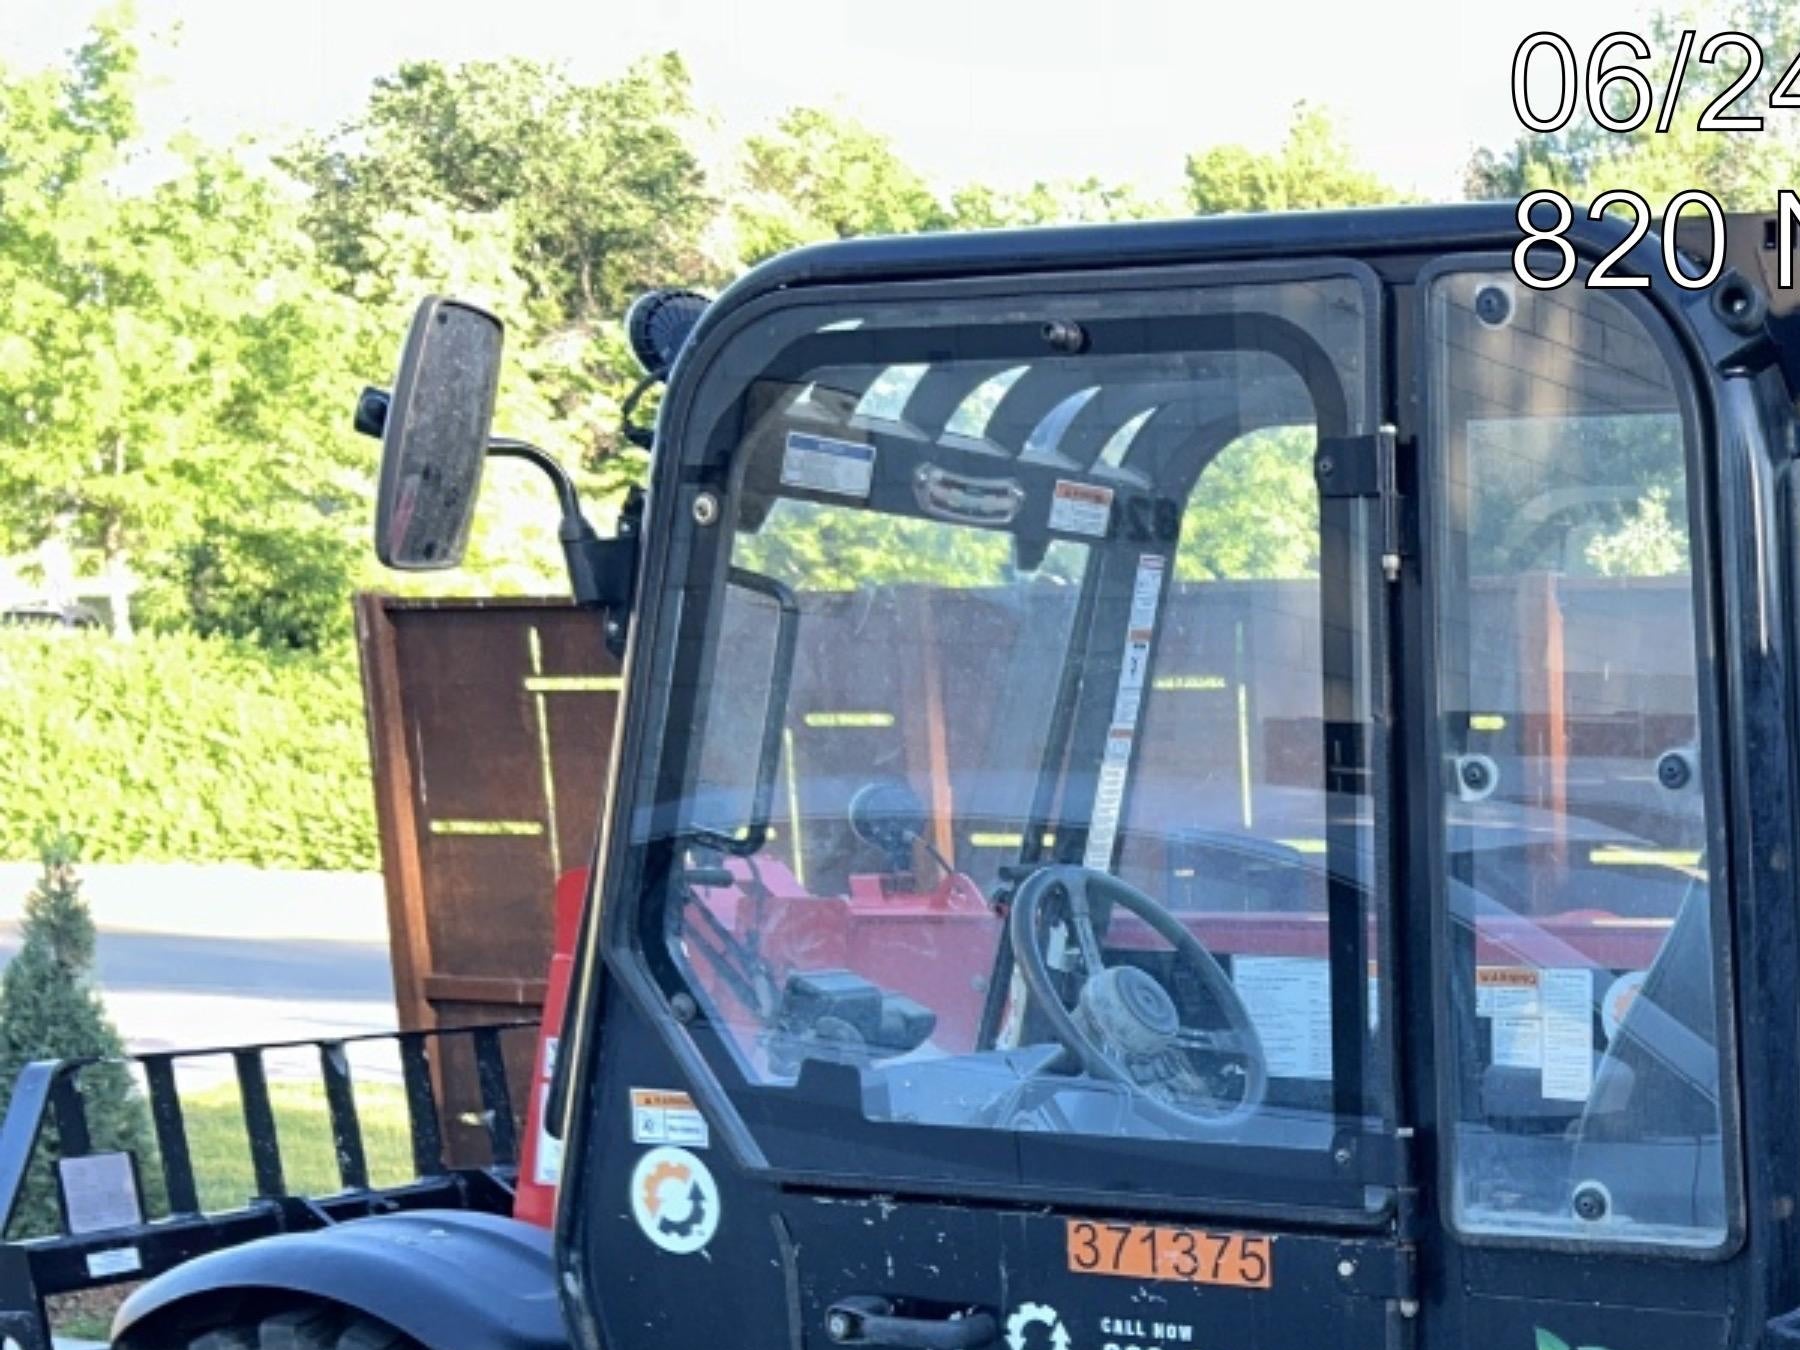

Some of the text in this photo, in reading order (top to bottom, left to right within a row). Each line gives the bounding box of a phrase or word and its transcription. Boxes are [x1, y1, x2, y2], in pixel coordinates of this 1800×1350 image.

[1073, 1222, 1268, 1283] 371375
[1101, 1317, 1194, 1342] CALL NOW
